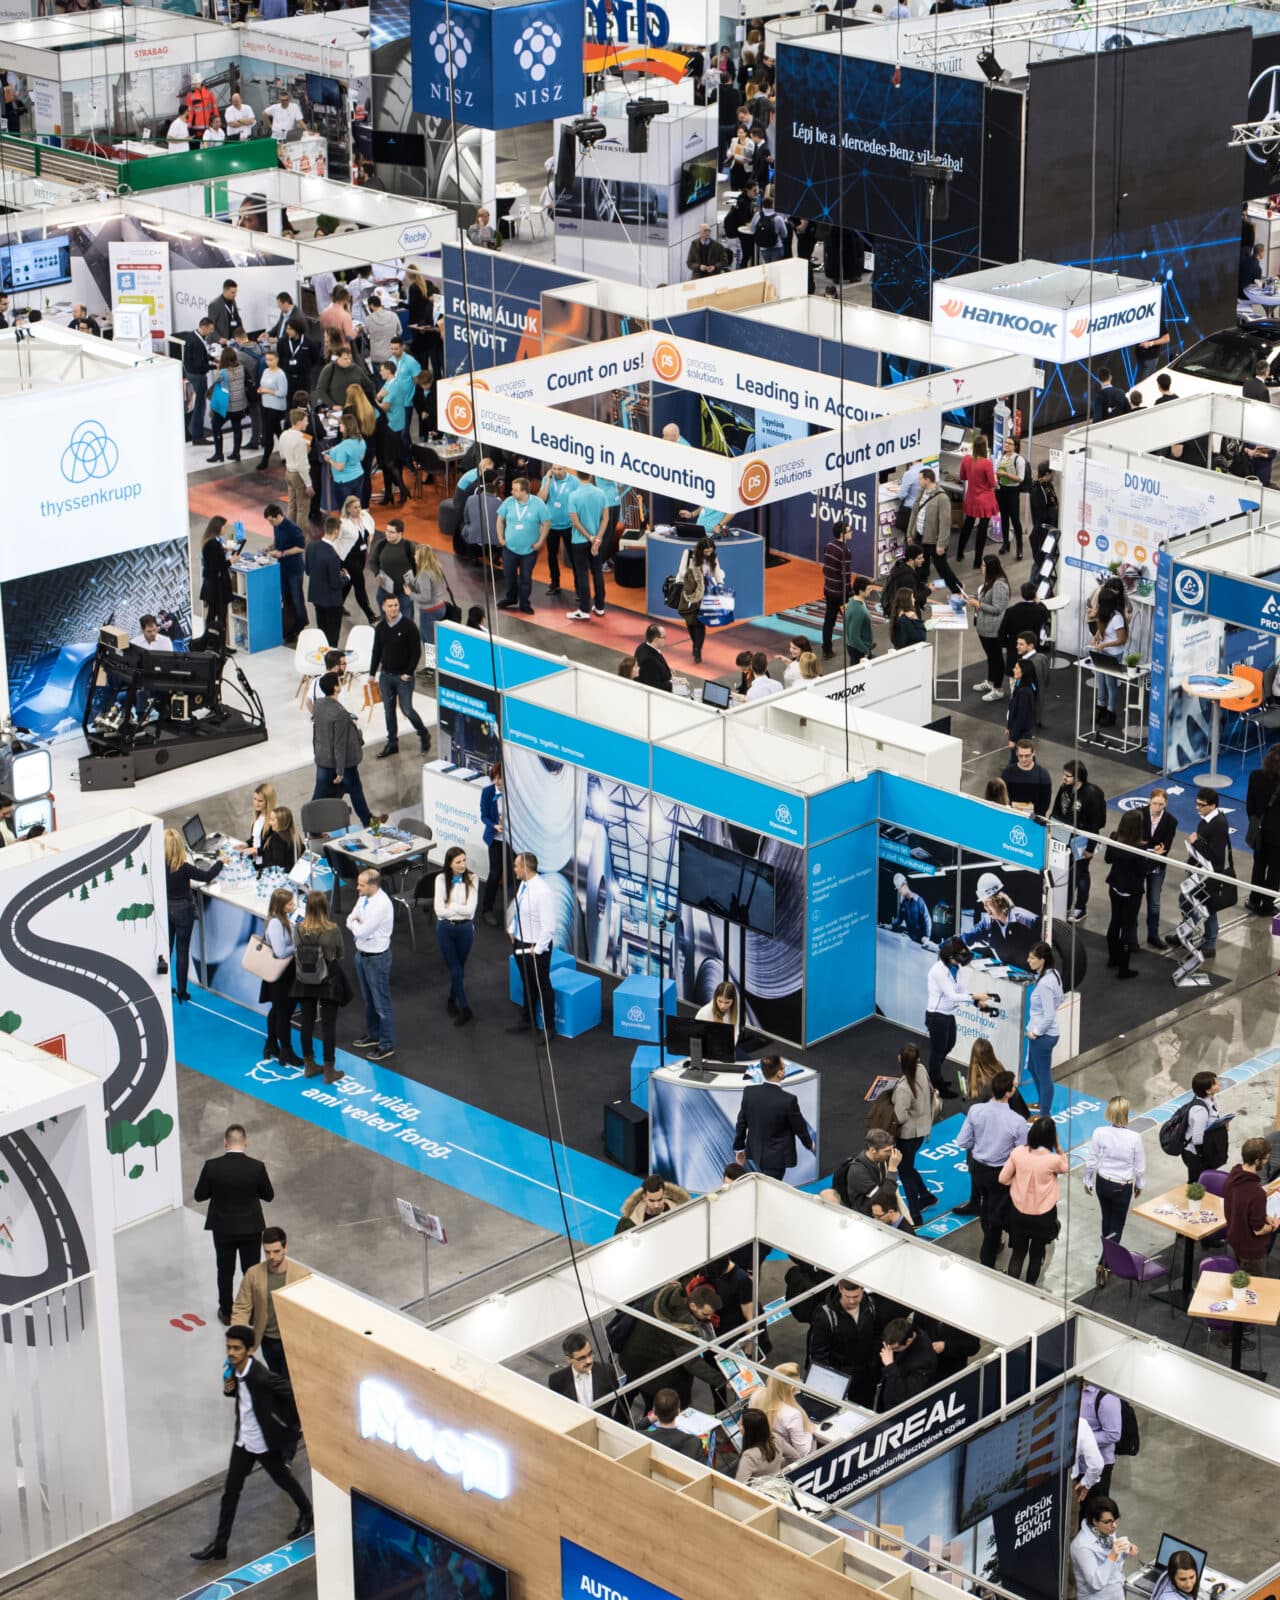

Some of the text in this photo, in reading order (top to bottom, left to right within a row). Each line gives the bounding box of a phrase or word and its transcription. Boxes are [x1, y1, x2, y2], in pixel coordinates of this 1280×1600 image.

[134, 46, 169, 58] STRABAG
[430, 82, 474, 108] NISZ
[514, 84, 563, 108] NISZ
[793, 122, 813, 144] Lépj
[816, 127, 828, 143] be
[830, 134, 836, 145] a
[839, 132, 914, 162] Mercedes-Benz
[404, 229, 427, 243] Roche
[452, 297, 537, 334] FORMÁLJUK
[454, 325, 507, 352] EGYÜTT
[547, 352, 645, 392] Count on us!
[687, 357, 717, 373] process
[687, 369, 724, 386] solutions
[495, 377, 527, 394] process
[736, 373, 819, 410] Leading in
[480, 408, 511, 425] process
[480, 421, 518, 439] solutions
[531, 426, 716, 498] Leading in Accounting
[825, 429, 921, 471] Count on us!
[774, 459, 805, 475] process
[774, 468, 812, 487] solutions
[1124, 472, 1139, 489] DO
[40, 480, 142, 517] thyssenkrupp
[1053, 842, 1065, 850] E11
[956, 1007, 998, 1031] omorrow.
[331, 1074, 422, 1121] Egy világ,
[301, 1088, 453, 1160] ami veled forog.
[1054, 1100, 1102, 1125] orog.
[794, 1392, 966, 1494] FUTUREAL
[826, 1474, 868, 1502] legnagyobb
[944, 1418, 966, 1434] egyike
[1015, 1494, 1053, 1525] ÉPÍTSÜK
[1017, 1506, 1052, 1536] EGYÜTT
[1022, 1519, 1052, 1547] JÖVŐT!
